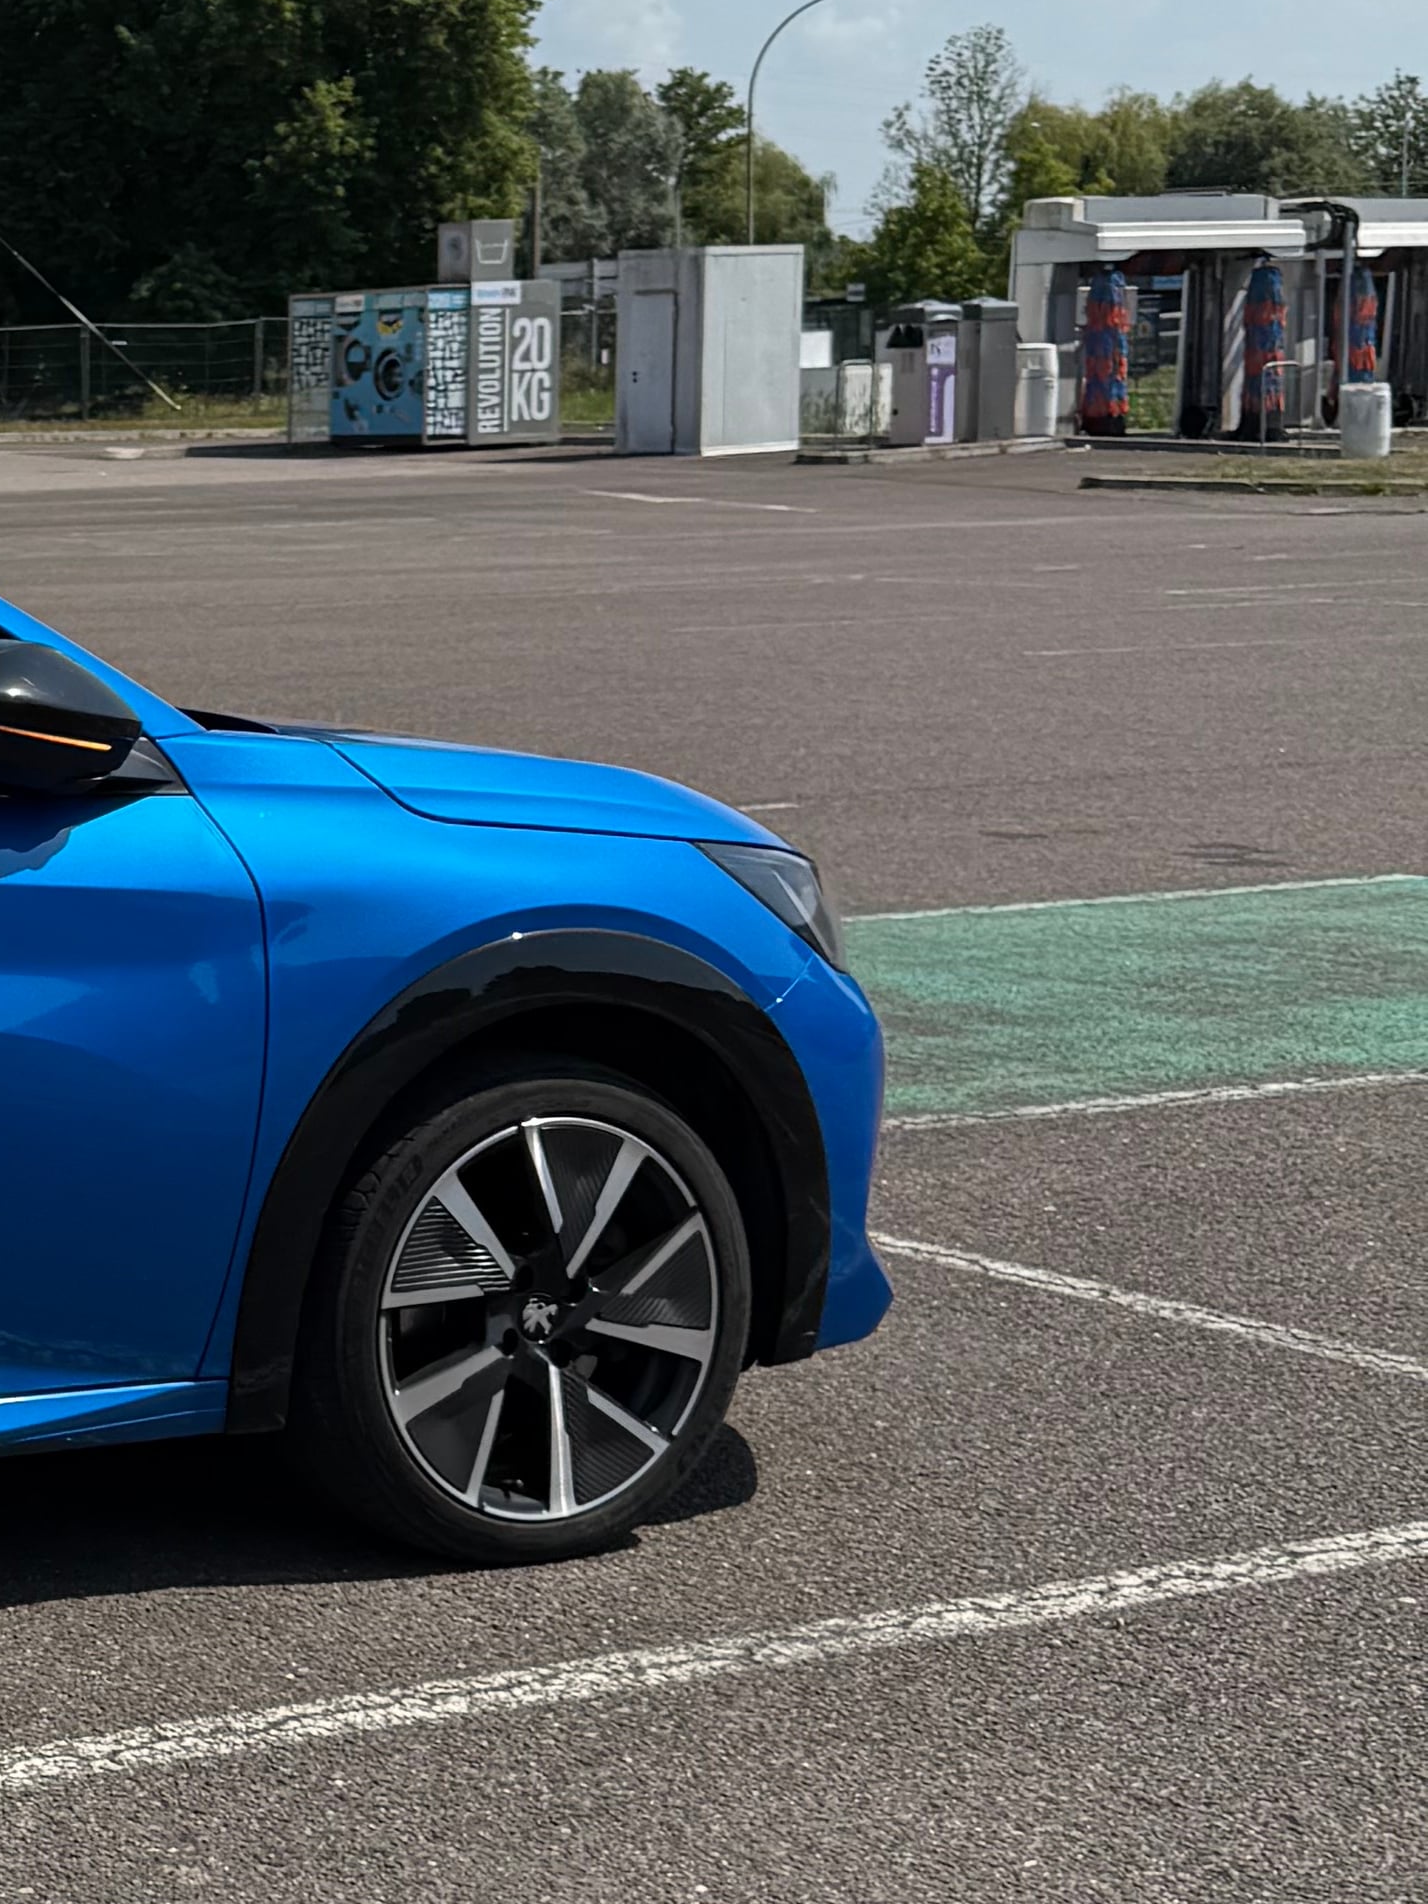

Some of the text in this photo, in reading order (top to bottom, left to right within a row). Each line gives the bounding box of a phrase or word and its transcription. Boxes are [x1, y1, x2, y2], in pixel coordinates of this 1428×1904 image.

[477, 307, 504, 434] REVOLUTION
[511, 316, 552, 371] 20
[510, 370, 552, 422] KG
